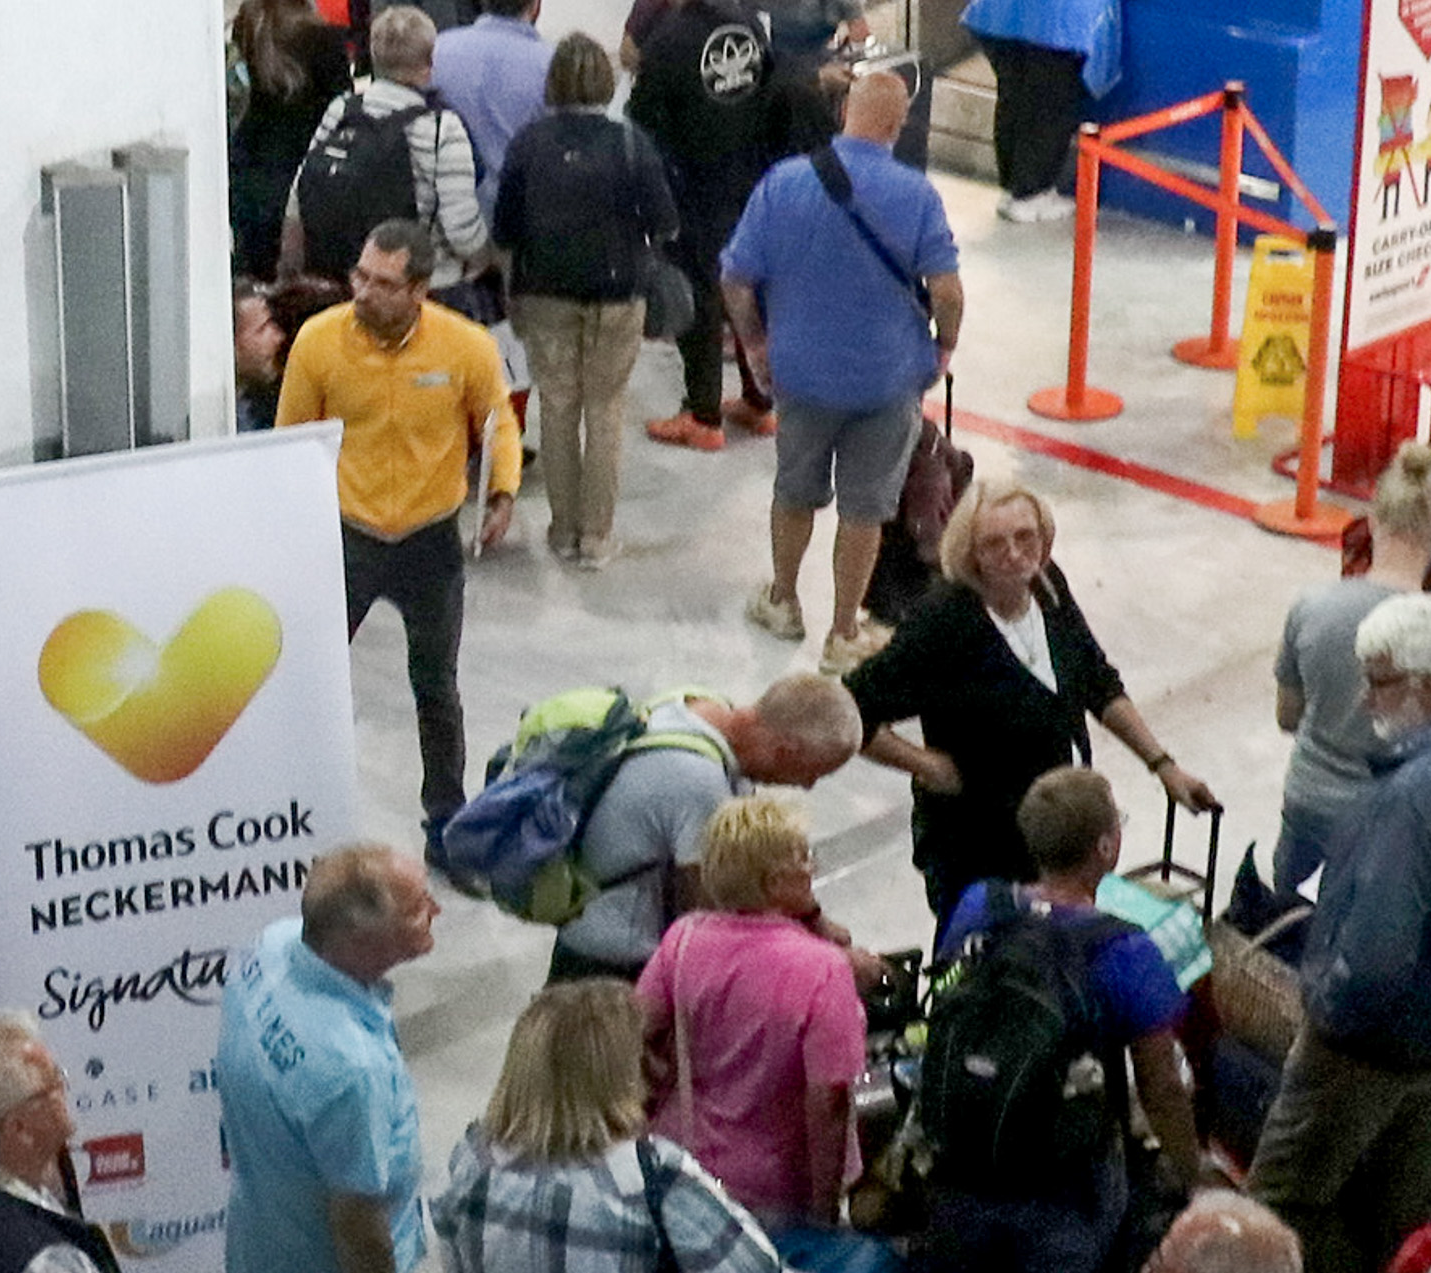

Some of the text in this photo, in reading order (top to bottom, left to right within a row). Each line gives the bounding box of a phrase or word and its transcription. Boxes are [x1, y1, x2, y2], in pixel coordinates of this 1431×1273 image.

[1364, 257, 1393, 279] SIZE
[25, 797, 315, 882] Thomas Cook
[38, 948, 230, 1033] Signatu
